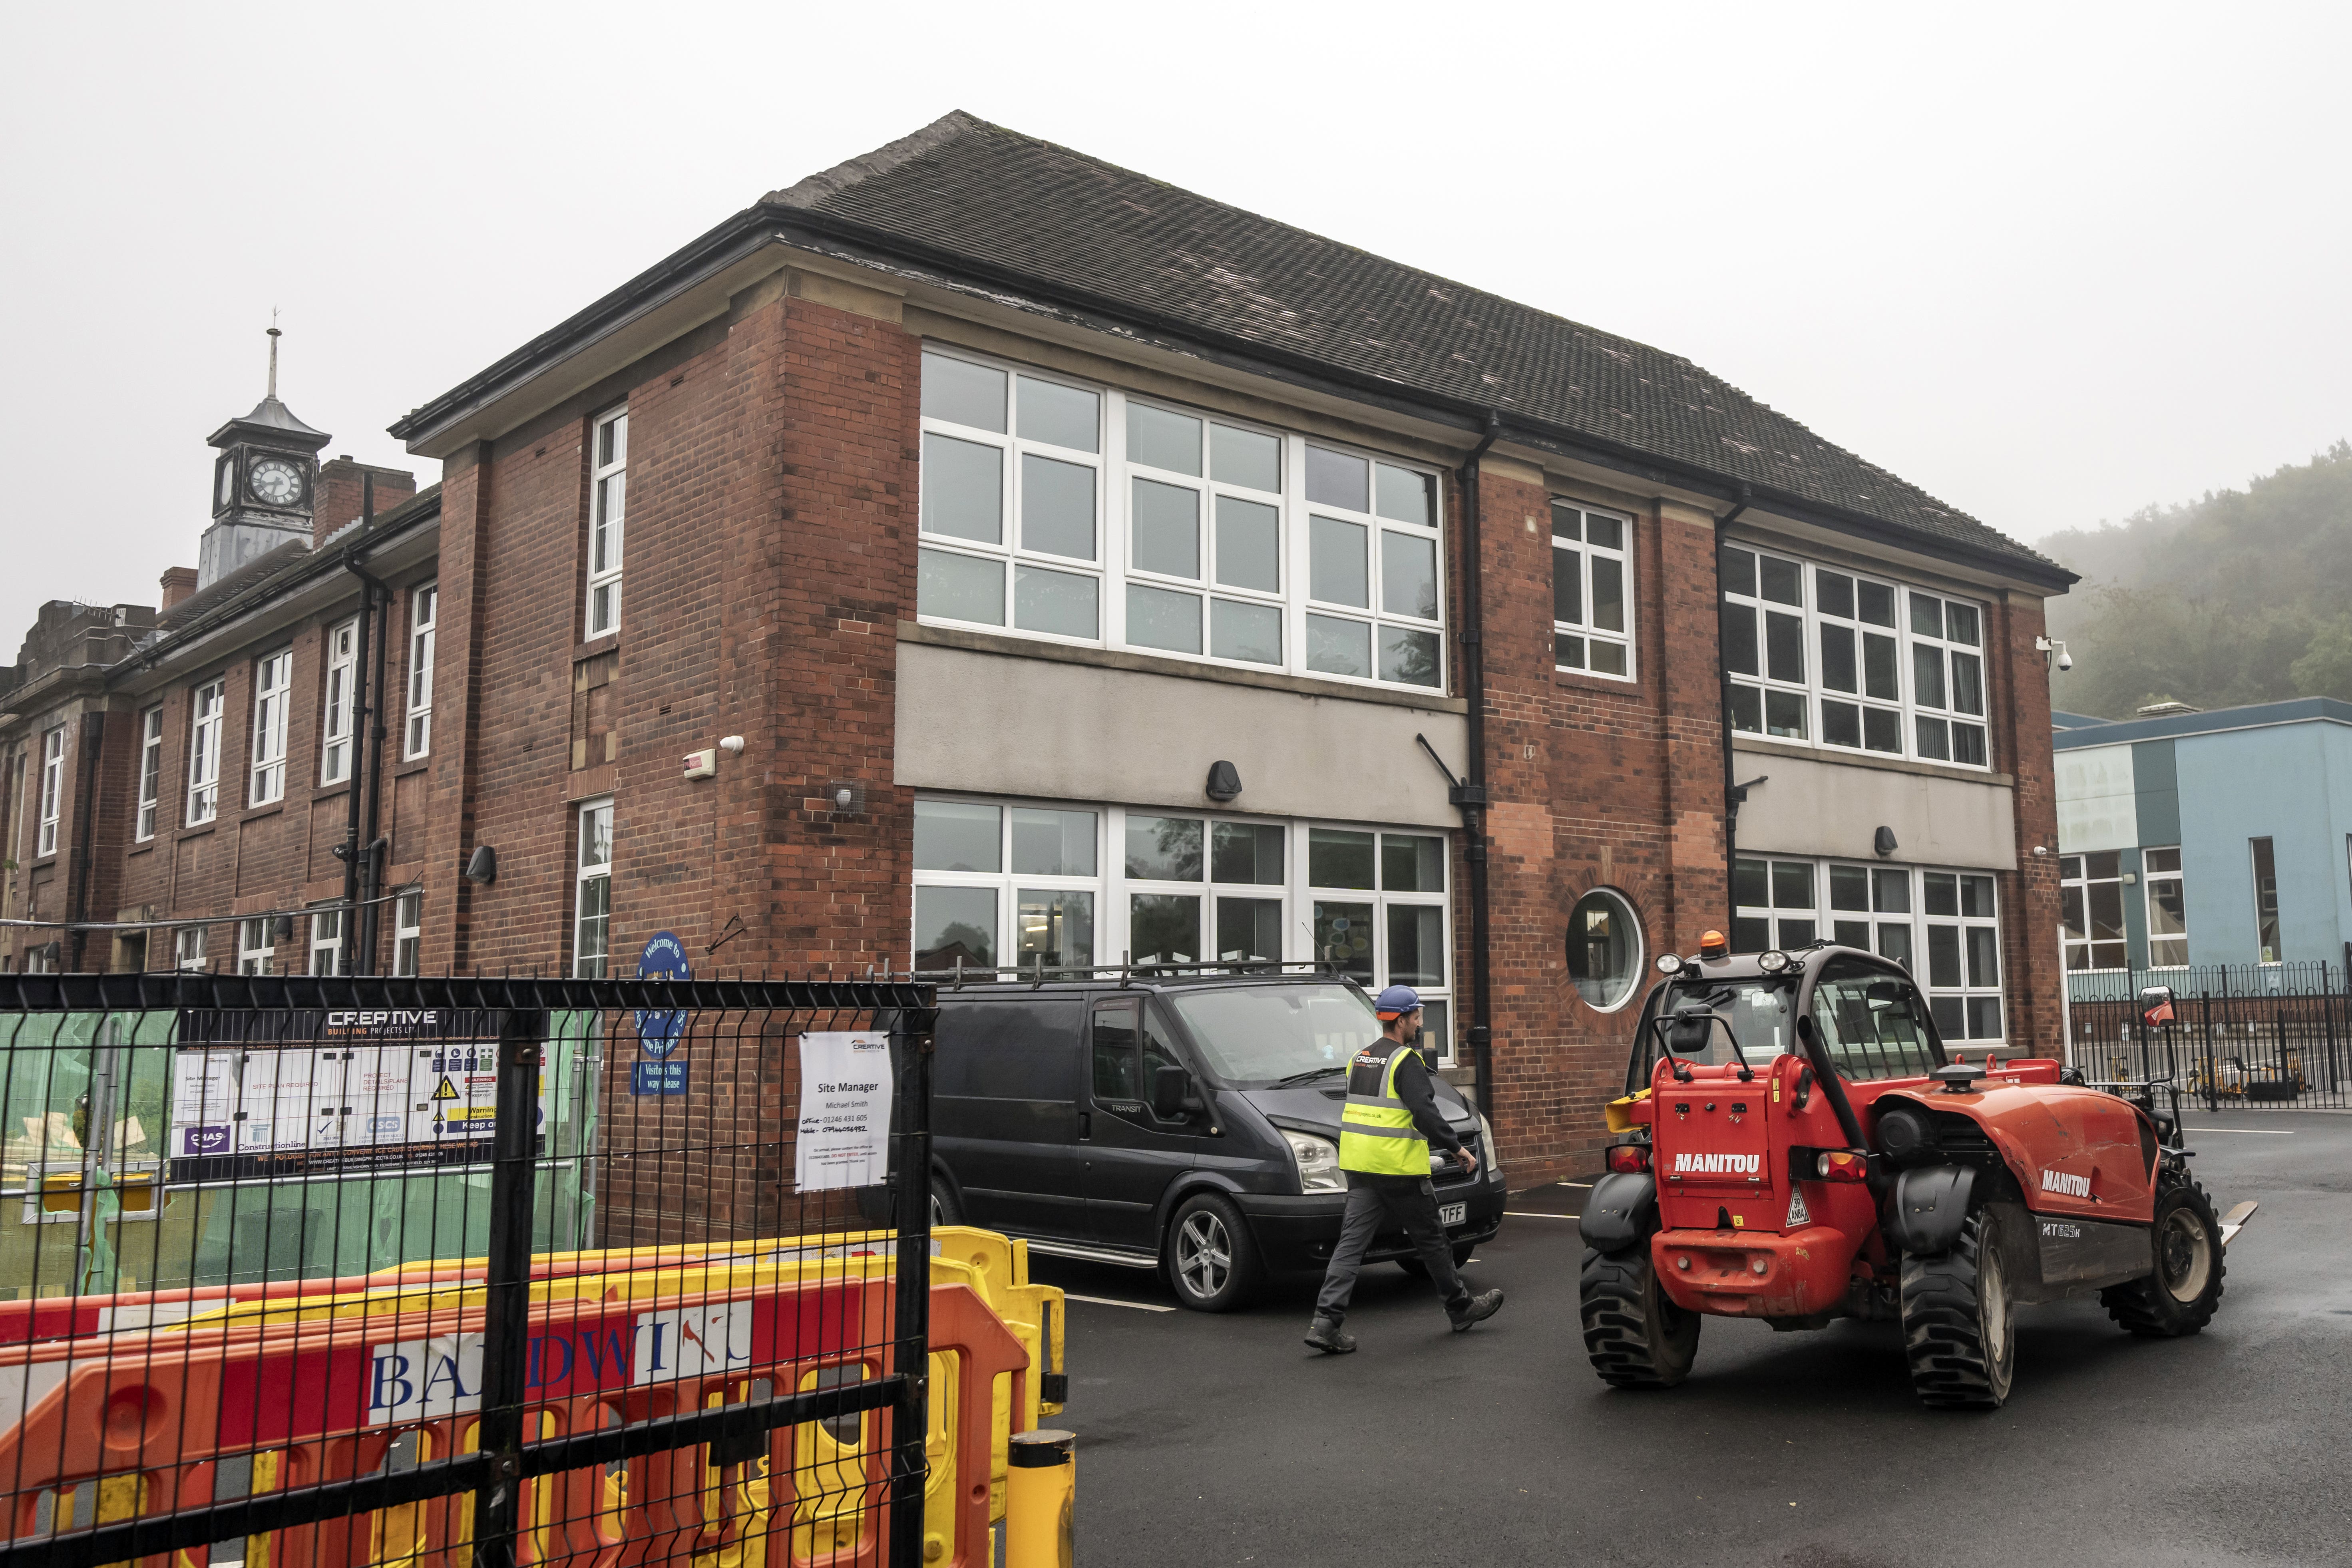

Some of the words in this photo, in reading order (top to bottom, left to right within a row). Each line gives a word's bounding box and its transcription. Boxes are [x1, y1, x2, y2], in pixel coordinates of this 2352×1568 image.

[645, 939, 673, 958] Welcome
[673, 943, 680, 958] to
[328, 1011, 436, 1025] CREATIVE
[1356, 1056, 1387, 1065] CREATIVE
[645, 1064, 668, 1075] Visitos
[669, 1064, 681, 1075] this
[647, 1080, 660, 1091] way
[818, 1083, 836, 1093] Site
[838, 1082, 879, 1093] Manager
[462, 1121, 485, 1130] Keep
[1675, 1153, 1760, 1173] MANITOU
[2042, 1169, 2090, 1198] MANITOU
[1794, 1198, 1800, 1209] 39
[1442, 1206, 1463, 1223] TFF
